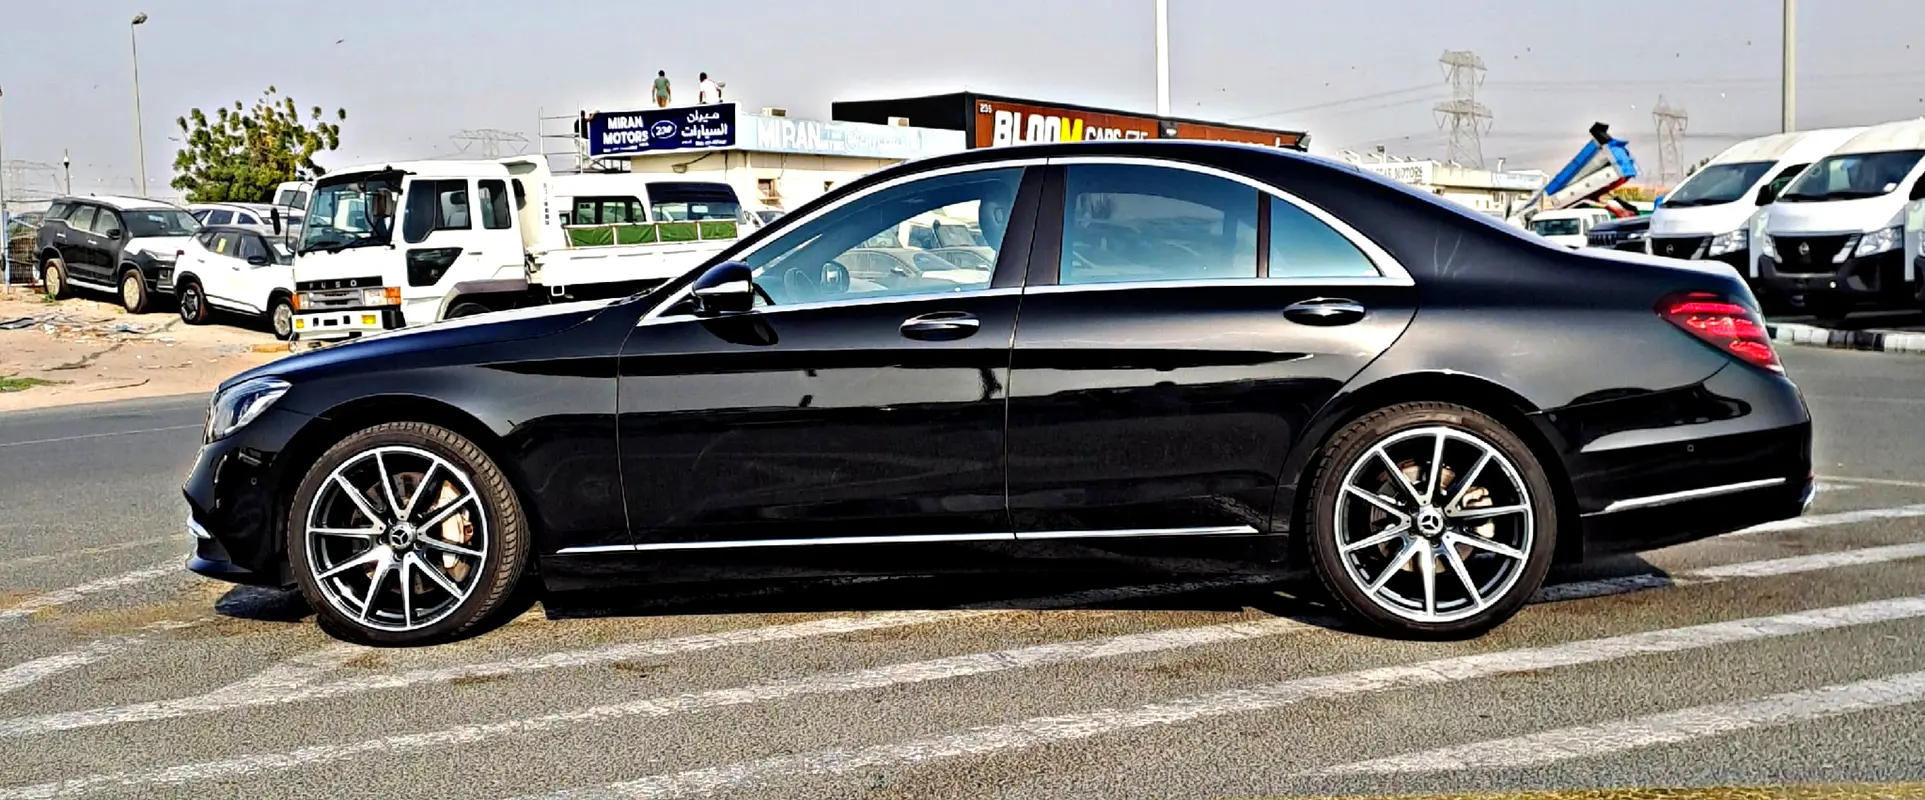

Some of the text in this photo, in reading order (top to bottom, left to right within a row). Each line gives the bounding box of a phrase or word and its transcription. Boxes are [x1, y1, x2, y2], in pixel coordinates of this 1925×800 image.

[608, 116, 643, 129] MIRAN
[686, 110, 720, 123] ميران
[681, 123, 728, 139] السيارات
[757, 118, 820, 149] MIRAN
[993, 110, 1083, 147] BLOOM
[603, 130, 648, 144] MOTORS
[309, 279, 357, 289] FUSO
